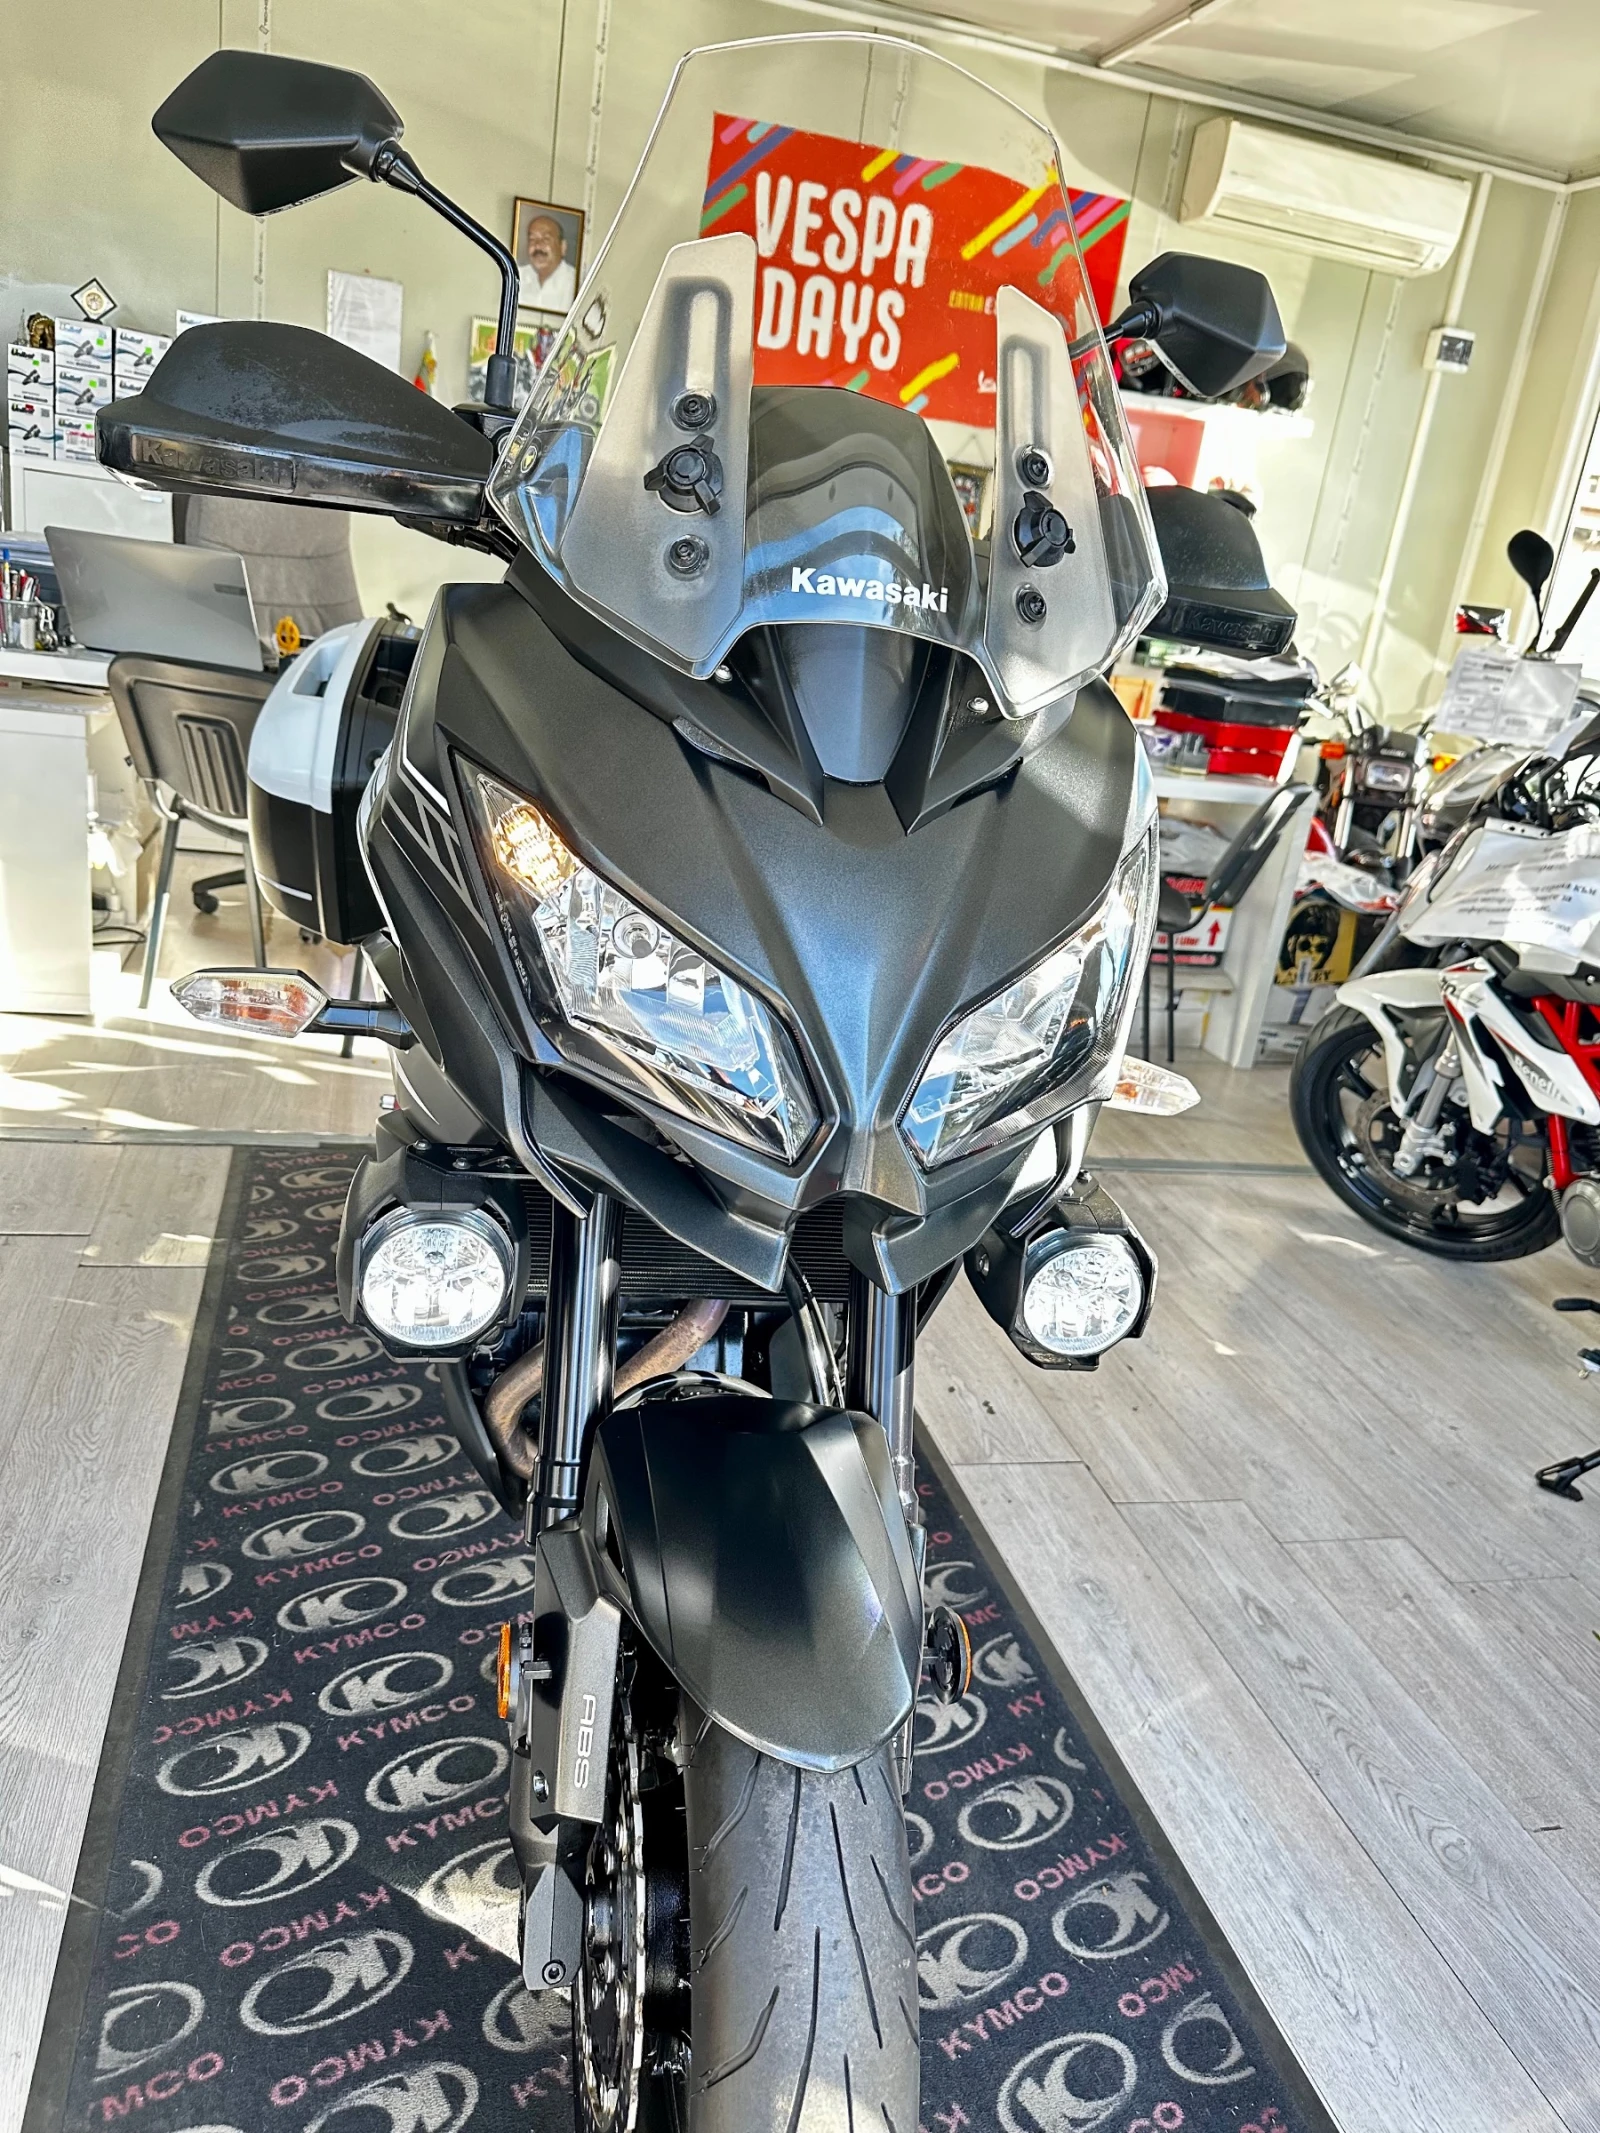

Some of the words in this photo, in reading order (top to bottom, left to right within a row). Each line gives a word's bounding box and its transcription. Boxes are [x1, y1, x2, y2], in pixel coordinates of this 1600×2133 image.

[755, 171, 934, 288] VESPA
[757, 266, 906, 371] DAYS
[142, 439, 283, 484] Kawasaki
[791, 566, 948, 613] Kawasaki
[1185, 608, 1278, 643] Kawasaki
[272, 1325, 354, 1346] YMCO
[302, 1366, 408, 1394] KYMCO
[336, 1415, 446, 1446] KYMCO
[222, 1481, 343, 1518] KYMCO
[254, 1544, 383, 1586] KYMCO
[293, 1613, 426, 1664] KYMCO
[337, 1695, 476, 1752] KYMCO
[574, 1694, 597, 1789] ABS
[924, 1742, 1033, 1800] KYMCO
[178, 1780, 339, 1848] KYMCO
[385, 1797, 505, 1853] KYMC
[1014, 1833, 1129, 1901] KYMCO
[219, 1885, 391, 1968] KYMCO
[937, 1971, 1070, 2061] KYMCO
[1118, 1963, 1202, 2018] MCO
[270, 2009, 452, 2107] KYMCO
[89, 2051, 224, 2122] MCO
